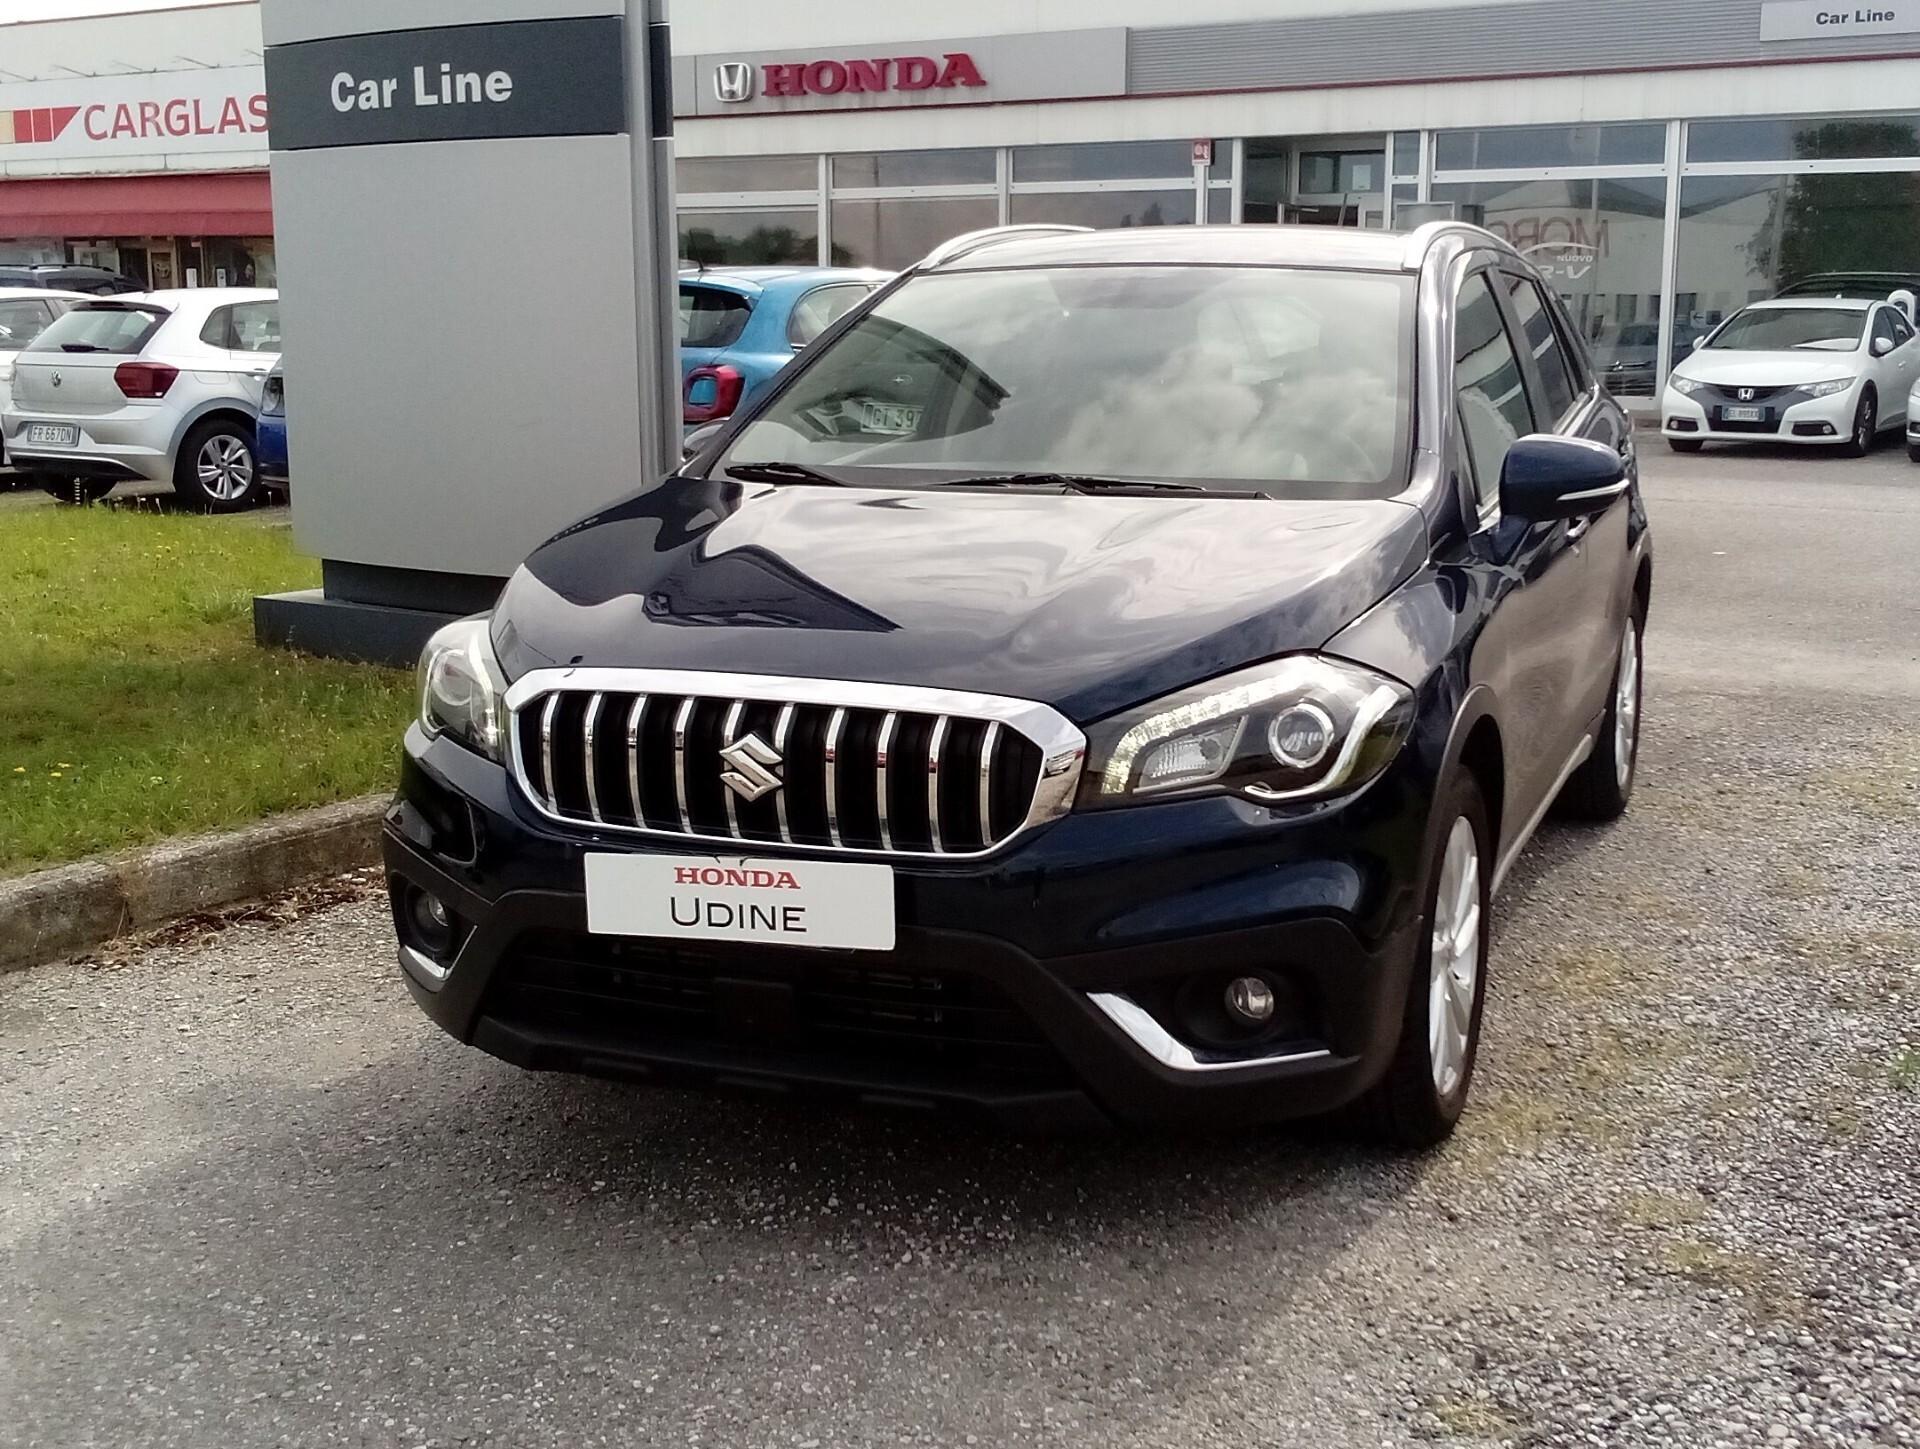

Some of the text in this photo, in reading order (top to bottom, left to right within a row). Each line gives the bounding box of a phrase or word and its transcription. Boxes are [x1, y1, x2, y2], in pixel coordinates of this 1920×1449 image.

[1816, 9, 1895, 25] Car Line
[331, 63, 513, 112] Car Line
[761, 53, 987, 97] HONDA
[32, 426, 43, 440] FR
[674, 867, 801, 889] HONDA
[670, 896, 807, 932] UDINE
